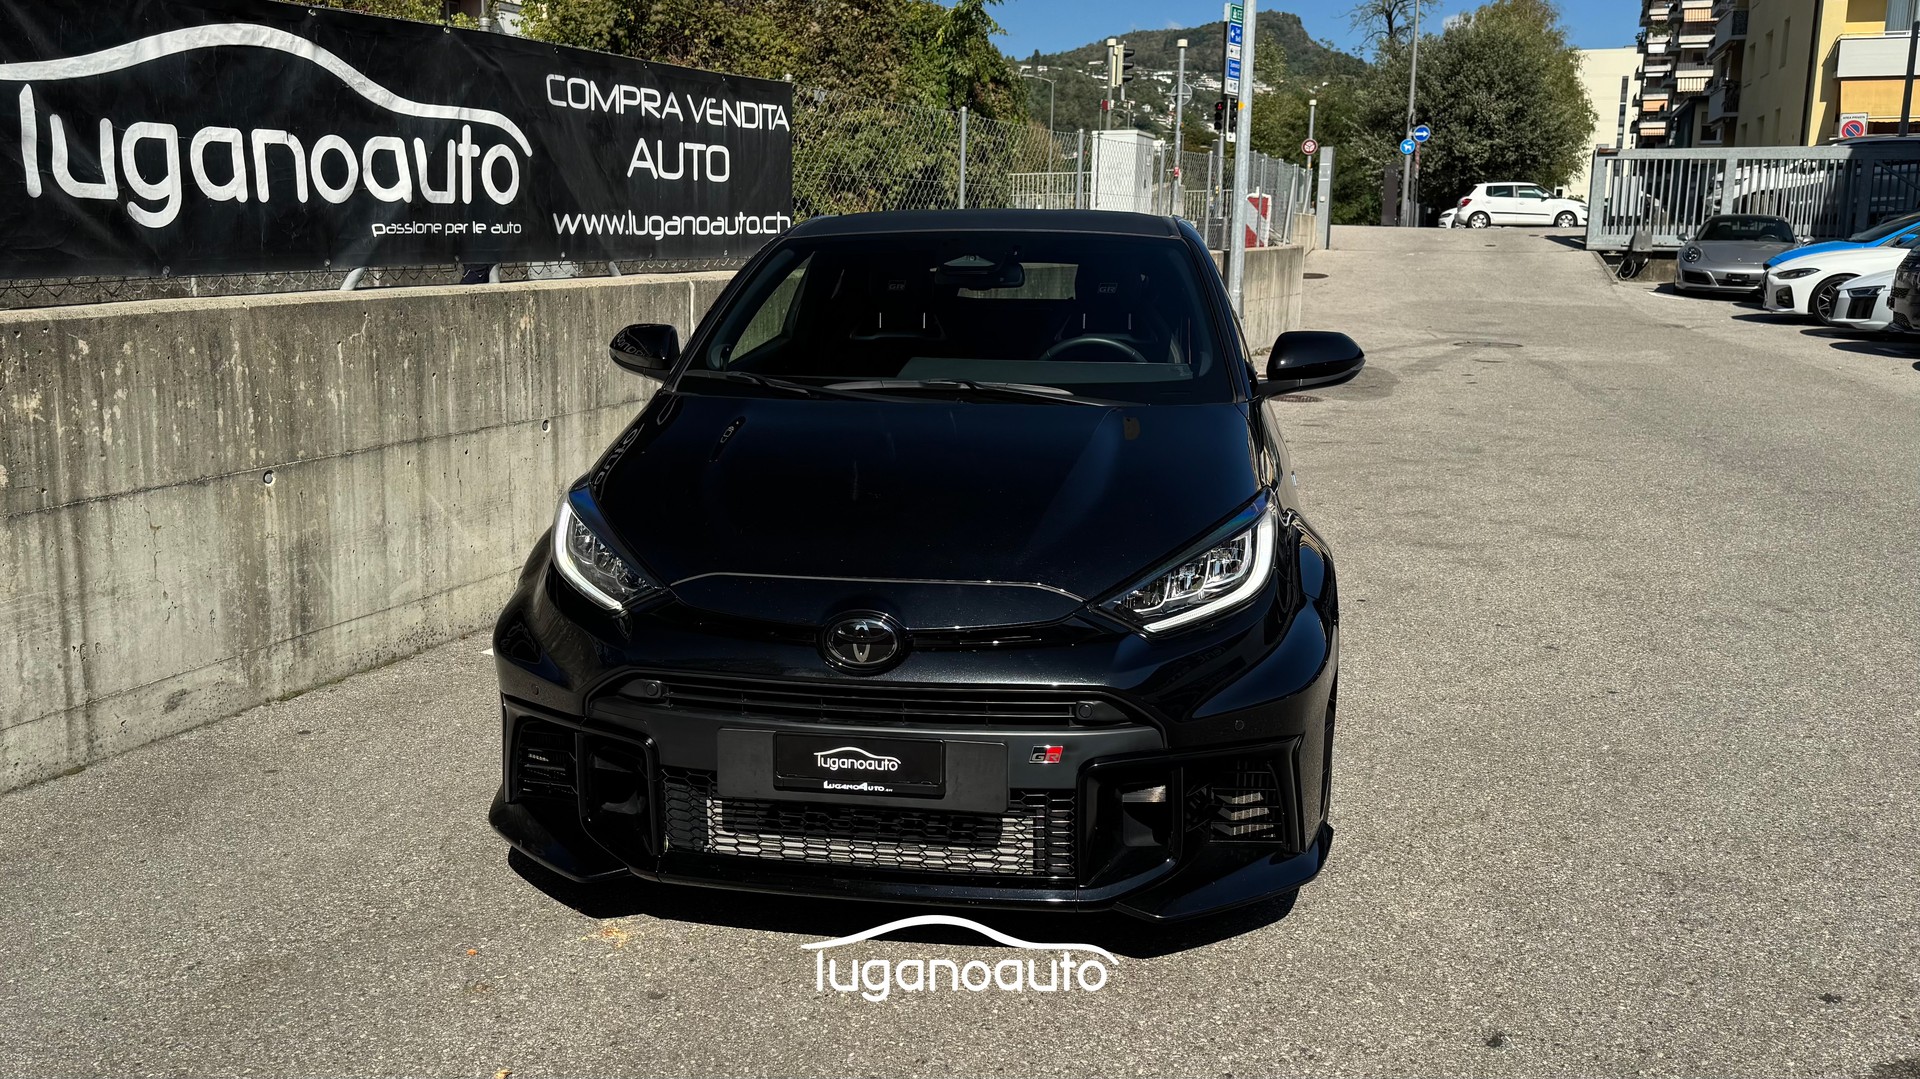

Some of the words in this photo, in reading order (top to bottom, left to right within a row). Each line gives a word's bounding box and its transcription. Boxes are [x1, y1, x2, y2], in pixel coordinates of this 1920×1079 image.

[545, 73, 684, 122] COMPRA
[686, 93, 791, 132] VENDITA
[18, 83, 520, 229] luganoauto
[626, 137, 730, 183] AUTO
[371, 220, 442, 237] passione
[445, 222, 469, 236] per
[472, 220, 487, 234] le
[490, 221, 522, 234] auto
[552, 209, 792, 241] www.luganoauto.ch
[817, 753, 899, 771] luganoauto
[1031, 752, 1061, 761] GR
